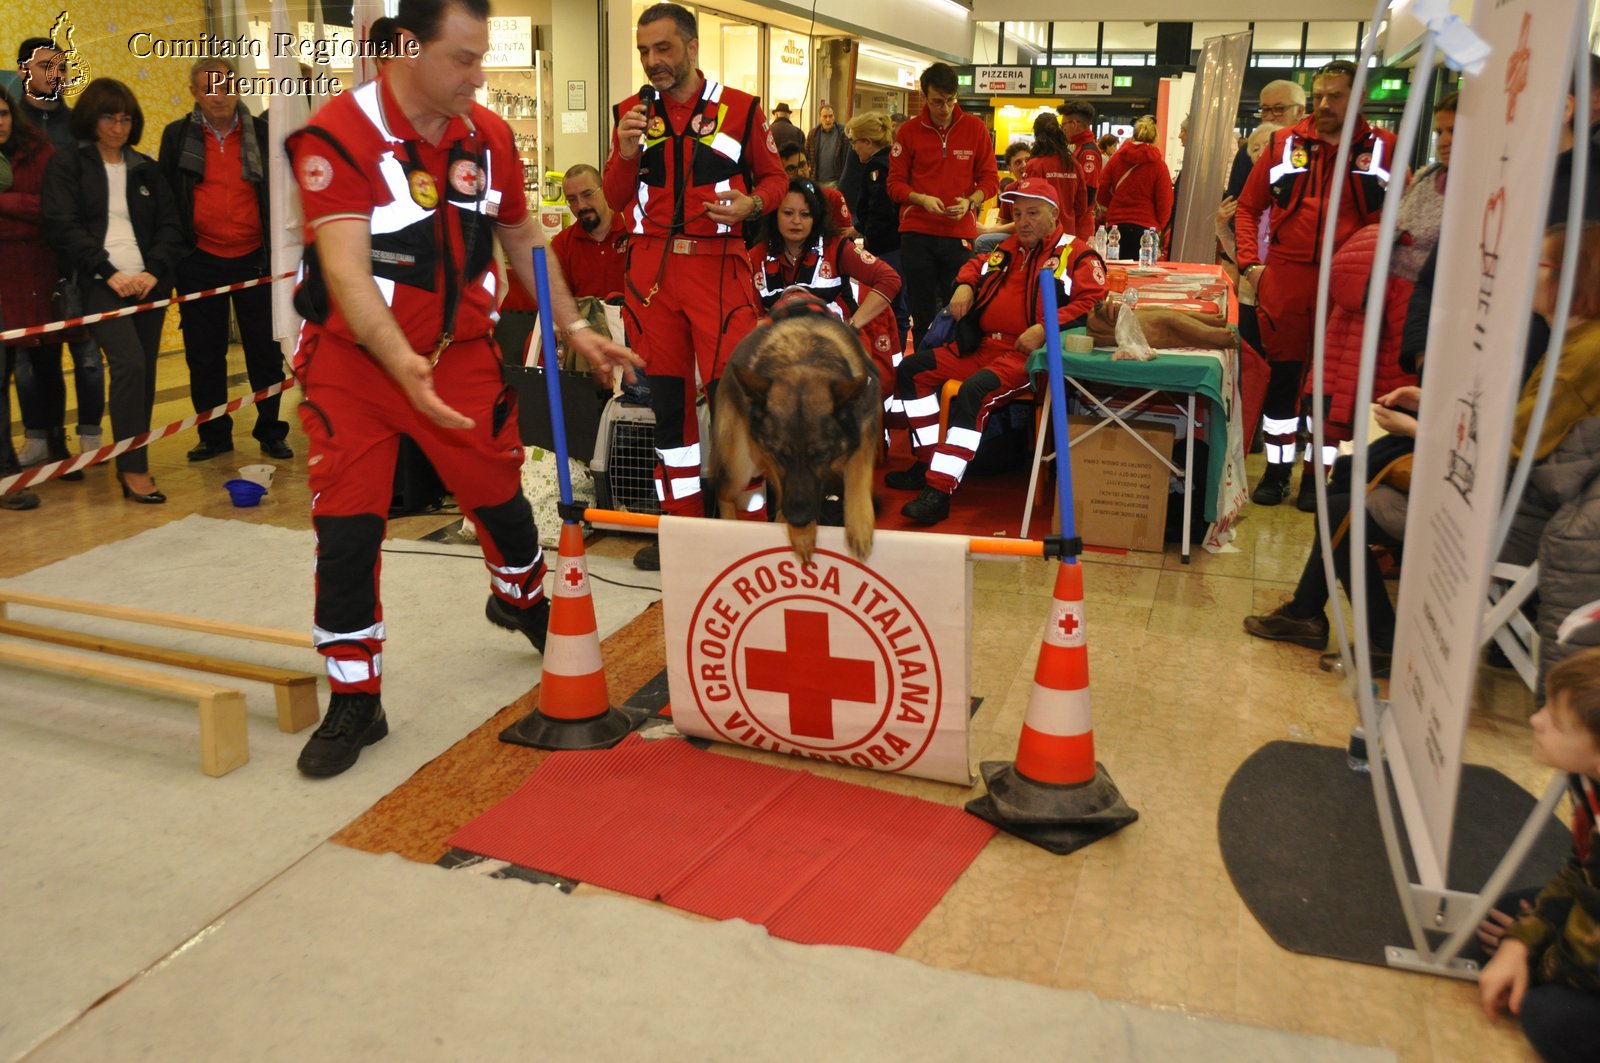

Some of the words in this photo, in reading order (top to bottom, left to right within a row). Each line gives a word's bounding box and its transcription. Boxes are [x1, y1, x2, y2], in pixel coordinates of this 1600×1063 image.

[487, 20, 517, 31] 1933
[489, 42, 525, 51] VENTA
[484, 53, 508, 63] OKA
[982, 70, 1024, 79] PIZZERIA
[700, 598, 741, 703] CROCE
[732, 560, 841, 606] ROSSA
[851, 581, 930, 724] ITALIANA
